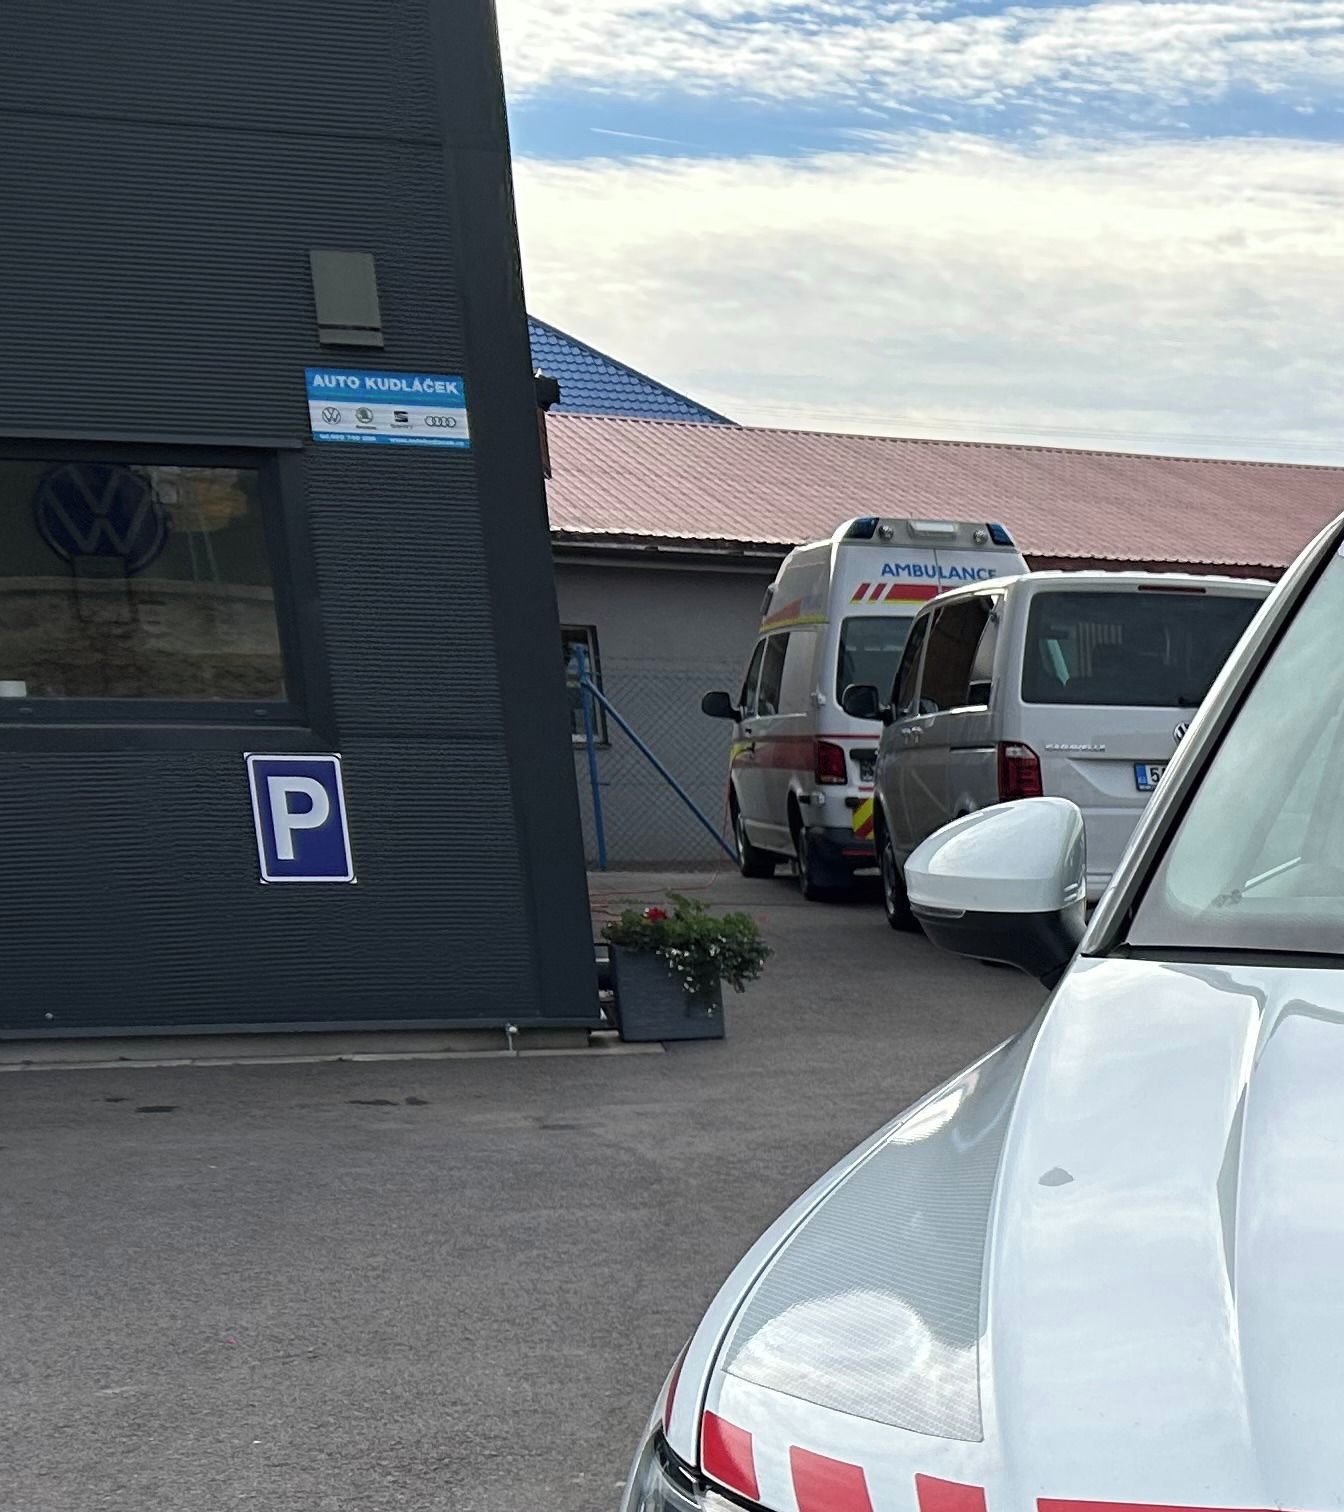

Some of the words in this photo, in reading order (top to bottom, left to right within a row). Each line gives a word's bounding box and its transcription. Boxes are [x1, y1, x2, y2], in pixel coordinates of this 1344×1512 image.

[313, 374, 360, 389] AUTO
[365, 377, 461, 396] KUDLÁČEK
[881, 563, 997, 580] AMBULANCE
[267, 775, 330, 860] P
